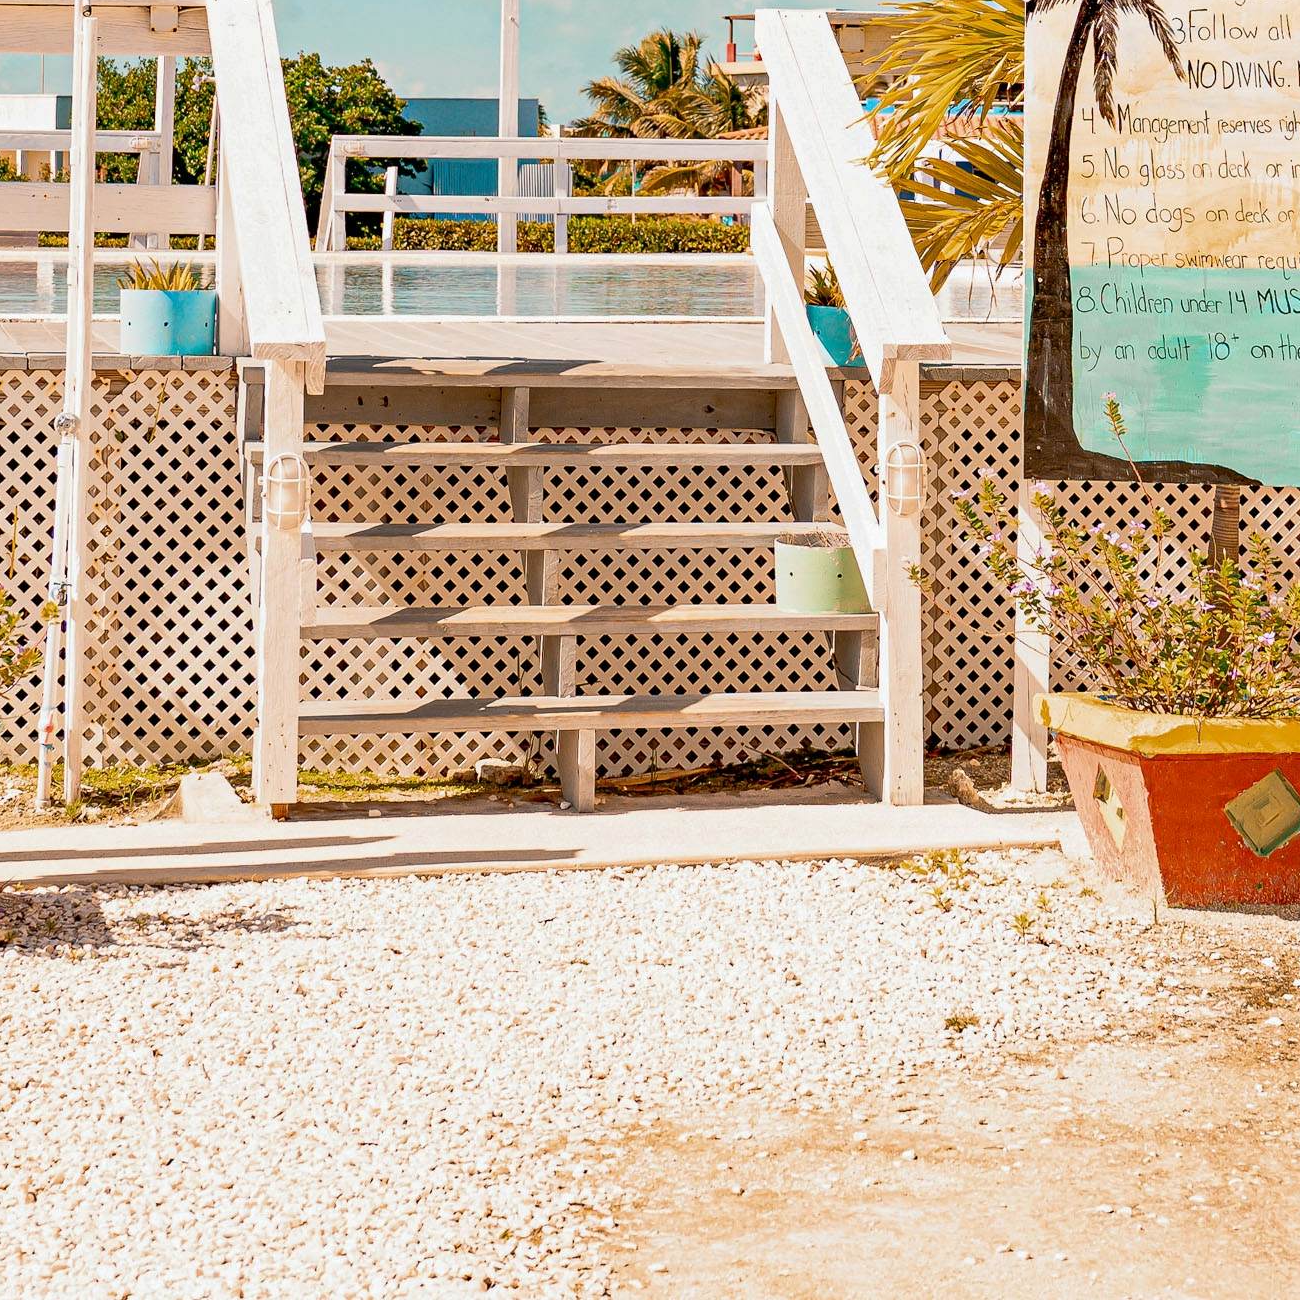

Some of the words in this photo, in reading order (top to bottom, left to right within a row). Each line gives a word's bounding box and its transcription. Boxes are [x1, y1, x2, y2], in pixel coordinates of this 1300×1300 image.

[1268, 14, 1292, 41] all
[1188, 59, 1217, 89] NO
[1222, 60, 1291, 89] DIVING.
[1115, 103, 1210, 143] Management
[1217, 116, 1273, 134] reserves
[1103, 148, 1130, 180] No
[1139, 150, 1186, 187] glass
[1192, 162, 1213, 179] on
[1218, 151, 1252, 179] deck
[1265, 161, 1282, 178] or
[1080, 196, 1100, 225] 6.
[1104, 194, 1137, 225] No
[1145, 192, 1196, 233] dogs
[1205, 206, 1229, 223] on
[1234, 198, 1271, 224] deck
[1277, 207, 1295, 223] or
[1080, 242, 1099, 268] 7.
[1106, 236, 1168, 278] Proper
[1174, 251, 1248, 270] swimwear
[1075, 286, 1099, 313] 8.
[1100, 282, 1174, 315] Children
[1180, 289, 1224, 314] under
[1227, 290, 1249, 314] 14
[1079, 330, 1103, 372] by
[1114, 344, 1136, 361] an
[1147, 335, 1191, 361] adult
[1208, 331, 1240, 361] 18+
[1250, 344, 1275, 360] on
